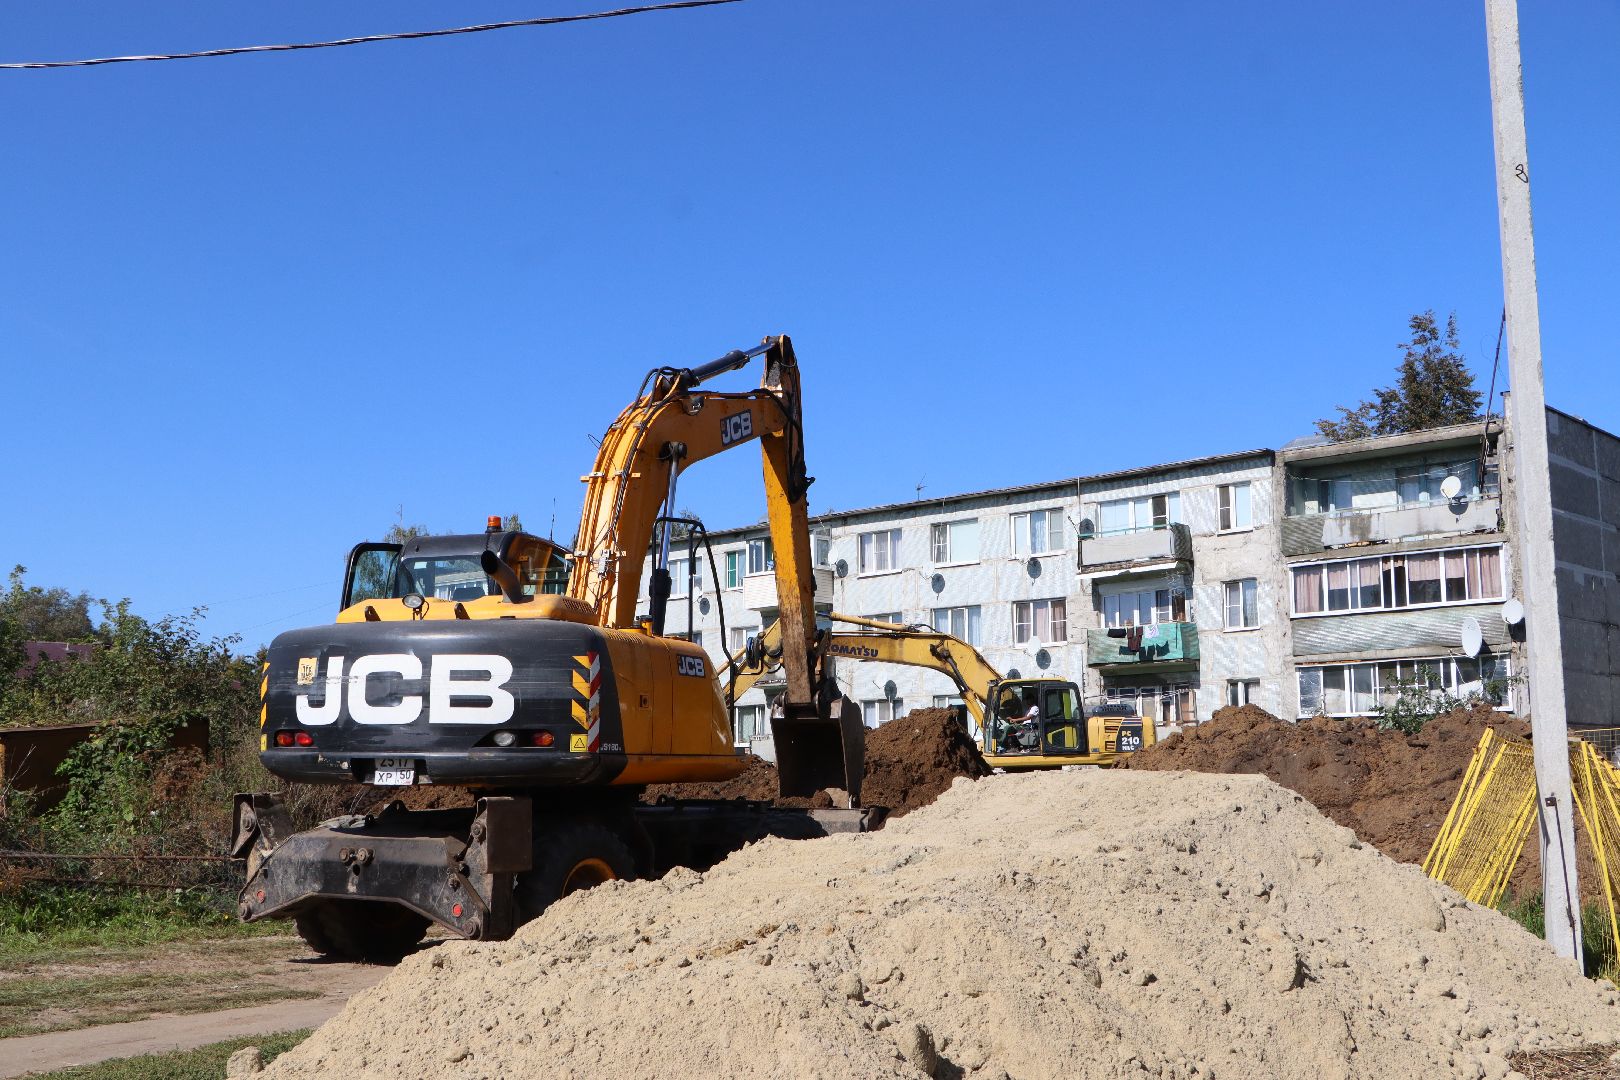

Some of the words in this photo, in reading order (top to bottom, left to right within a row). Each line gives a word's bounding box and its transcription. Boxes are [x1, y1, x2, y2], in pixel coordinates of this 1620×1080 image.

[721, 412, 752, 445] JCB
[828, 644, 879, 657] OMATSU
[678, 655, 705, 677] JCB
[295, 653, 515, 726] JCB
[1121, 736, 1140, 745] 210
[399, 769, 411, 780] 50
